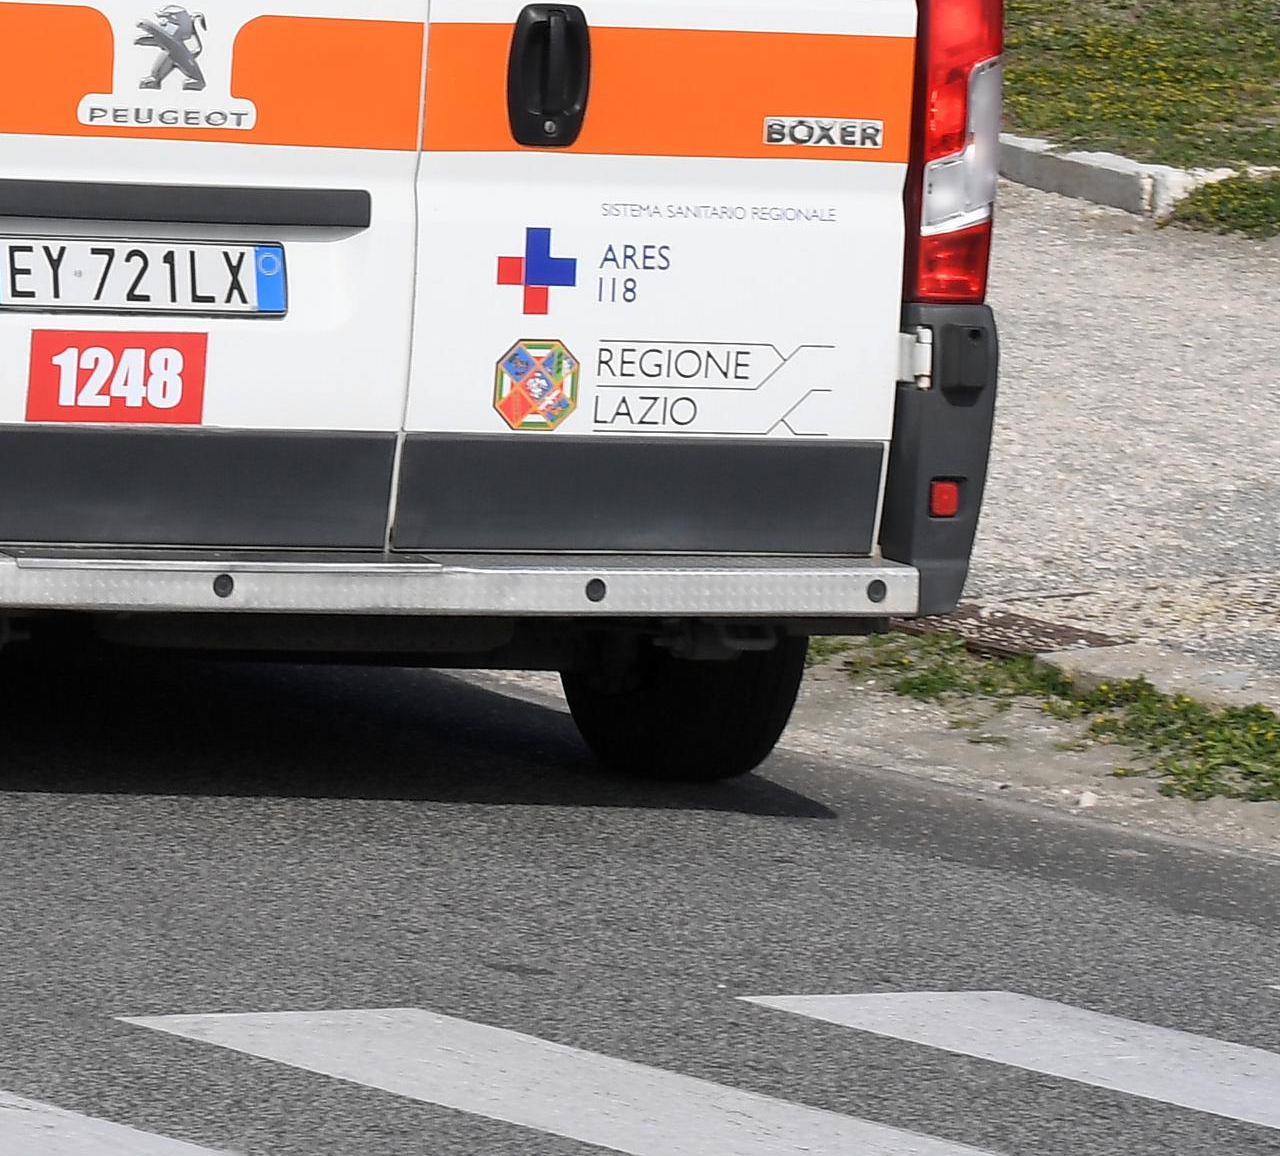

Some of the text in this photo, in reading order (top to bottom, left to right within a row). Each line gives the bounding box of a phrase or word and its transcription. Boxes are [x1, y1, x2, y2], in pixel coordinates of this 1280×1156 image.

[89, 107, 249, 128] PEUGEOT
[765, 118, 881, 147] BOXER
[600, 202, 837, 223] SISTEMA SANITARIO REGIONALE
[598, 244, 671, 271] ARES
[8, 245, 67, 300] EY
[90, 248, 249, 305] 721LX
[598, 277, 637, 303] 118
[51, 346, 185, 410] 1248
[596, 347, 751, 380] REGIONE
[592, 395, 698, 426] LAZIO
